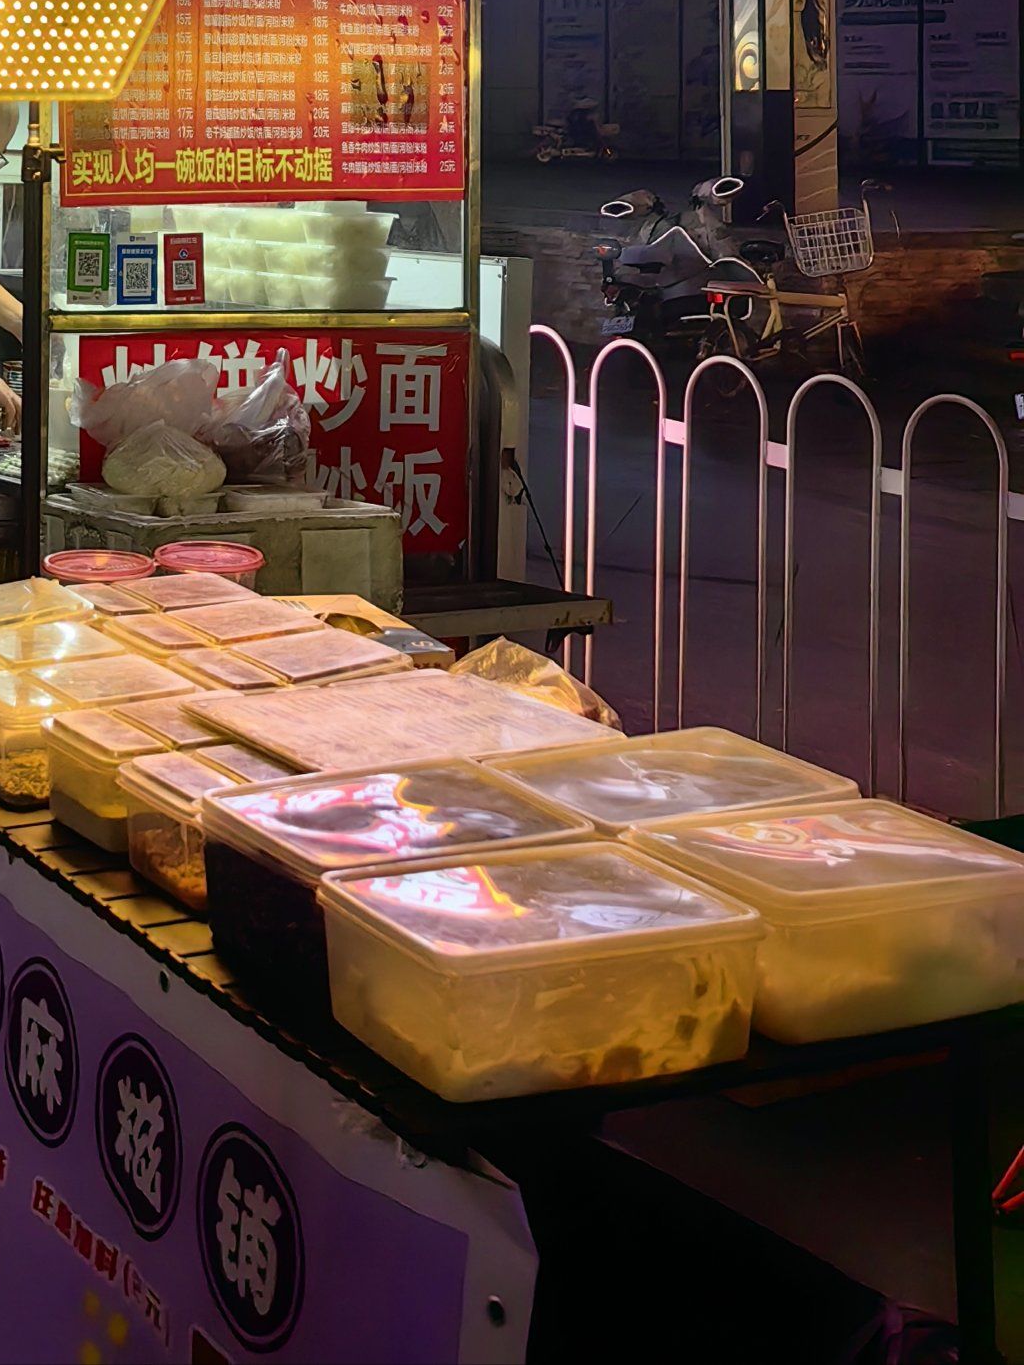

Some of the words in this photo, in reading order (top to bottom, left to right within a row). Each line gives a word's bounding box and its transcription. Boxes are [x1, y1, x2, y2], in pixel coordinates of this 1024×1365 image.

[72, 146, 333, 185] 实现人均一碗饭的目标不动摇
